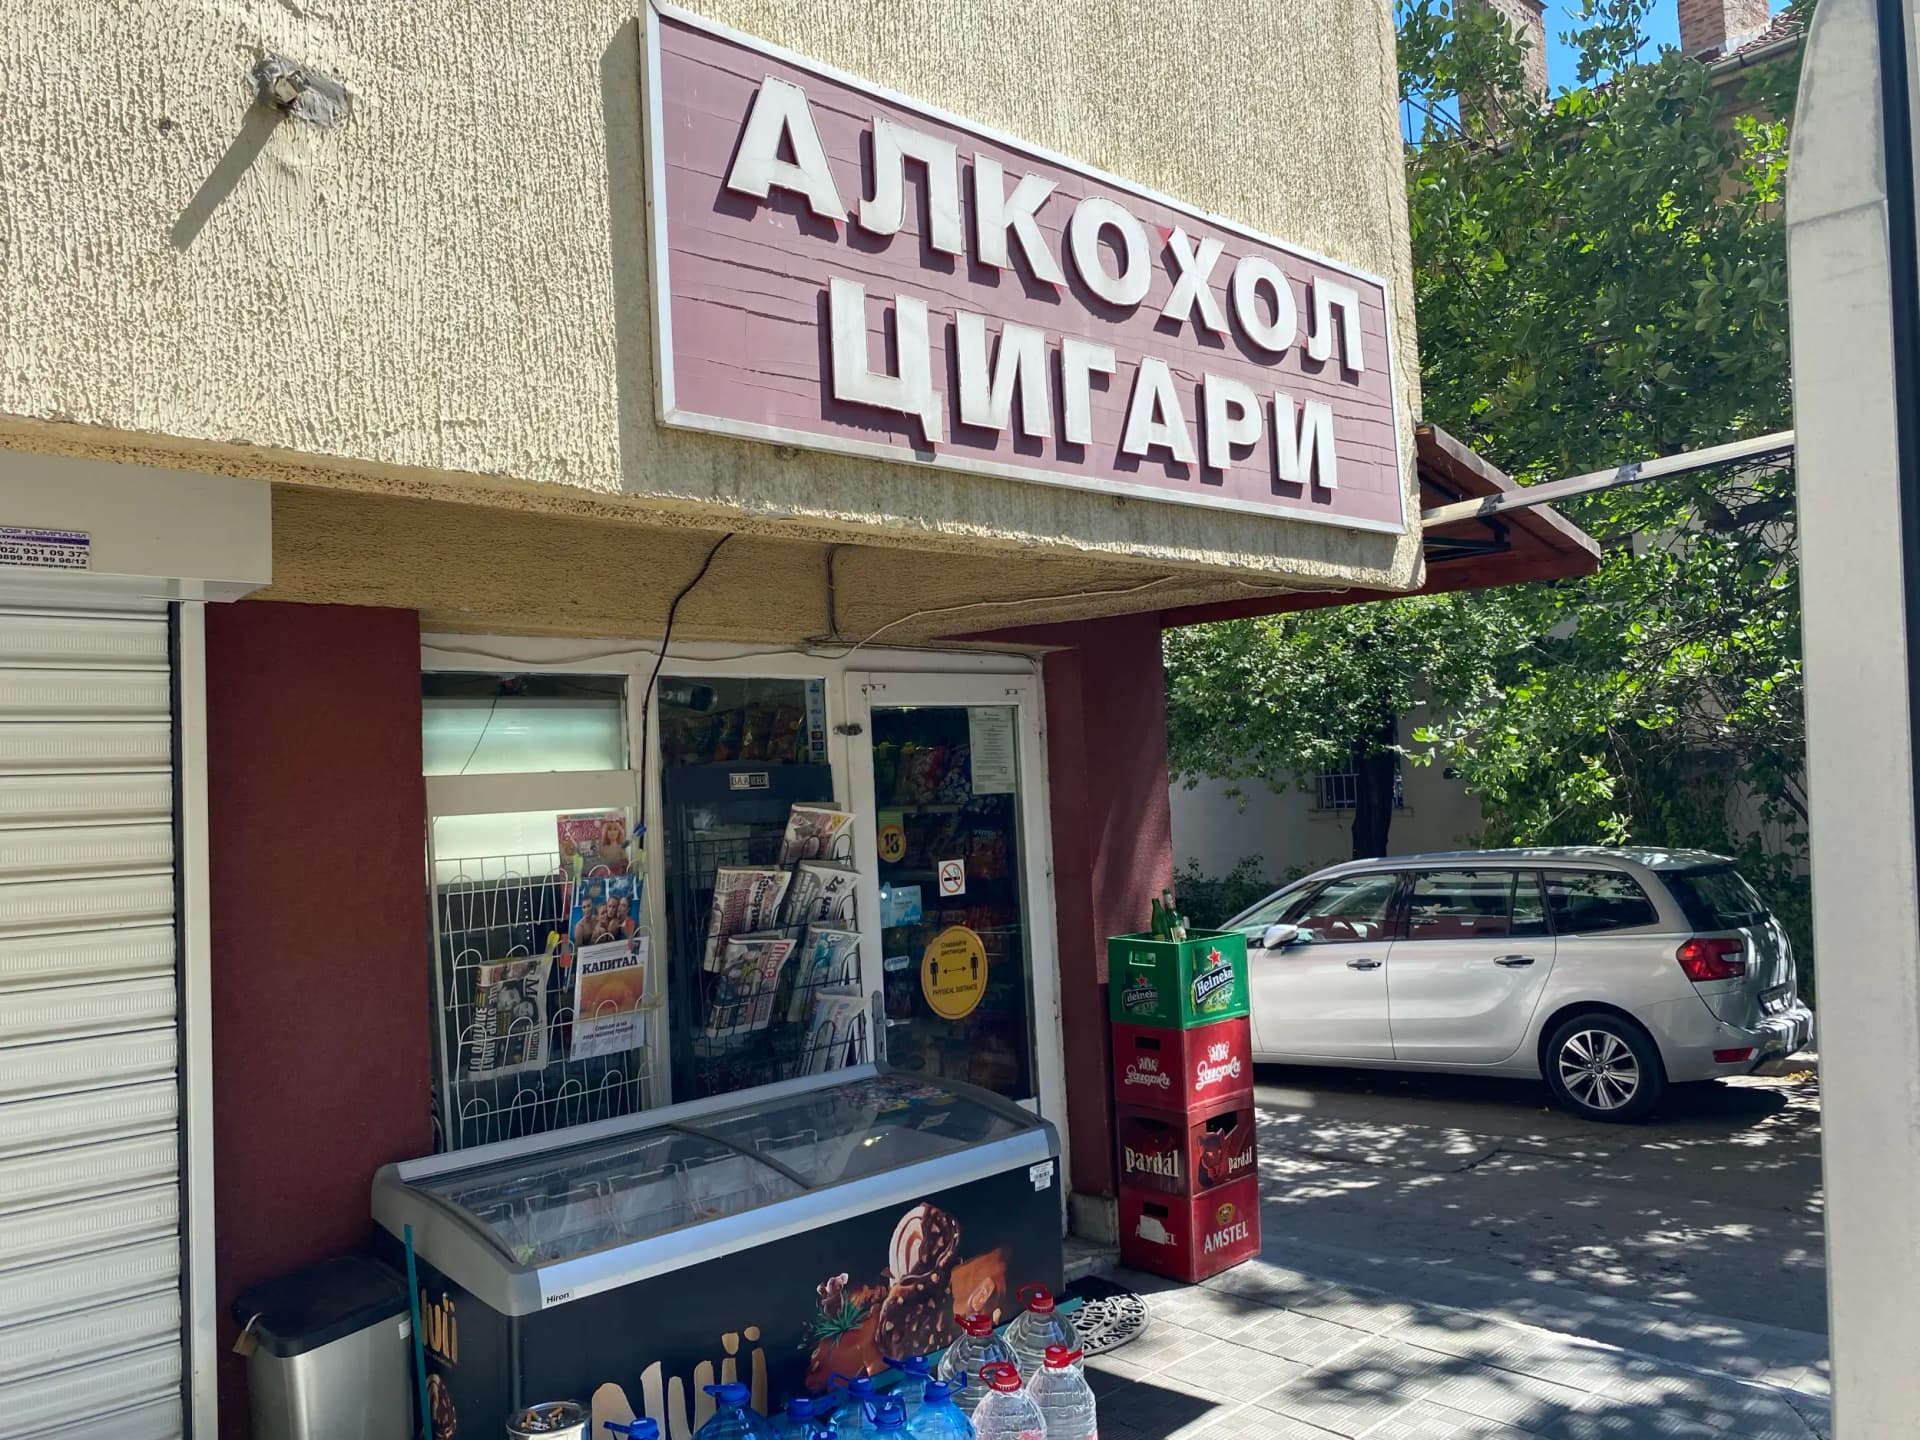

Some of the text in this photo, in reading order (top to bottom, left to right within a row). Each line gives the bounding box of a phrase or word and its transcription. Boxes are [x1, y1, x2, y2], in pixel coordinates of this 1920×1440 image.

[727, 74, 1365, 373] АЛКОХОЛ
[829, 275, 1338, 490] ЦИГАРИ
[49, 549, 65, 557] 09
[825, 875, 845, 893] 24
[582, 955, 638, 975] КАПИТАЛ
[1204, 1220, 1249, 1255] AMSTEL
[546, 1292, 570, 1304] Hiron
